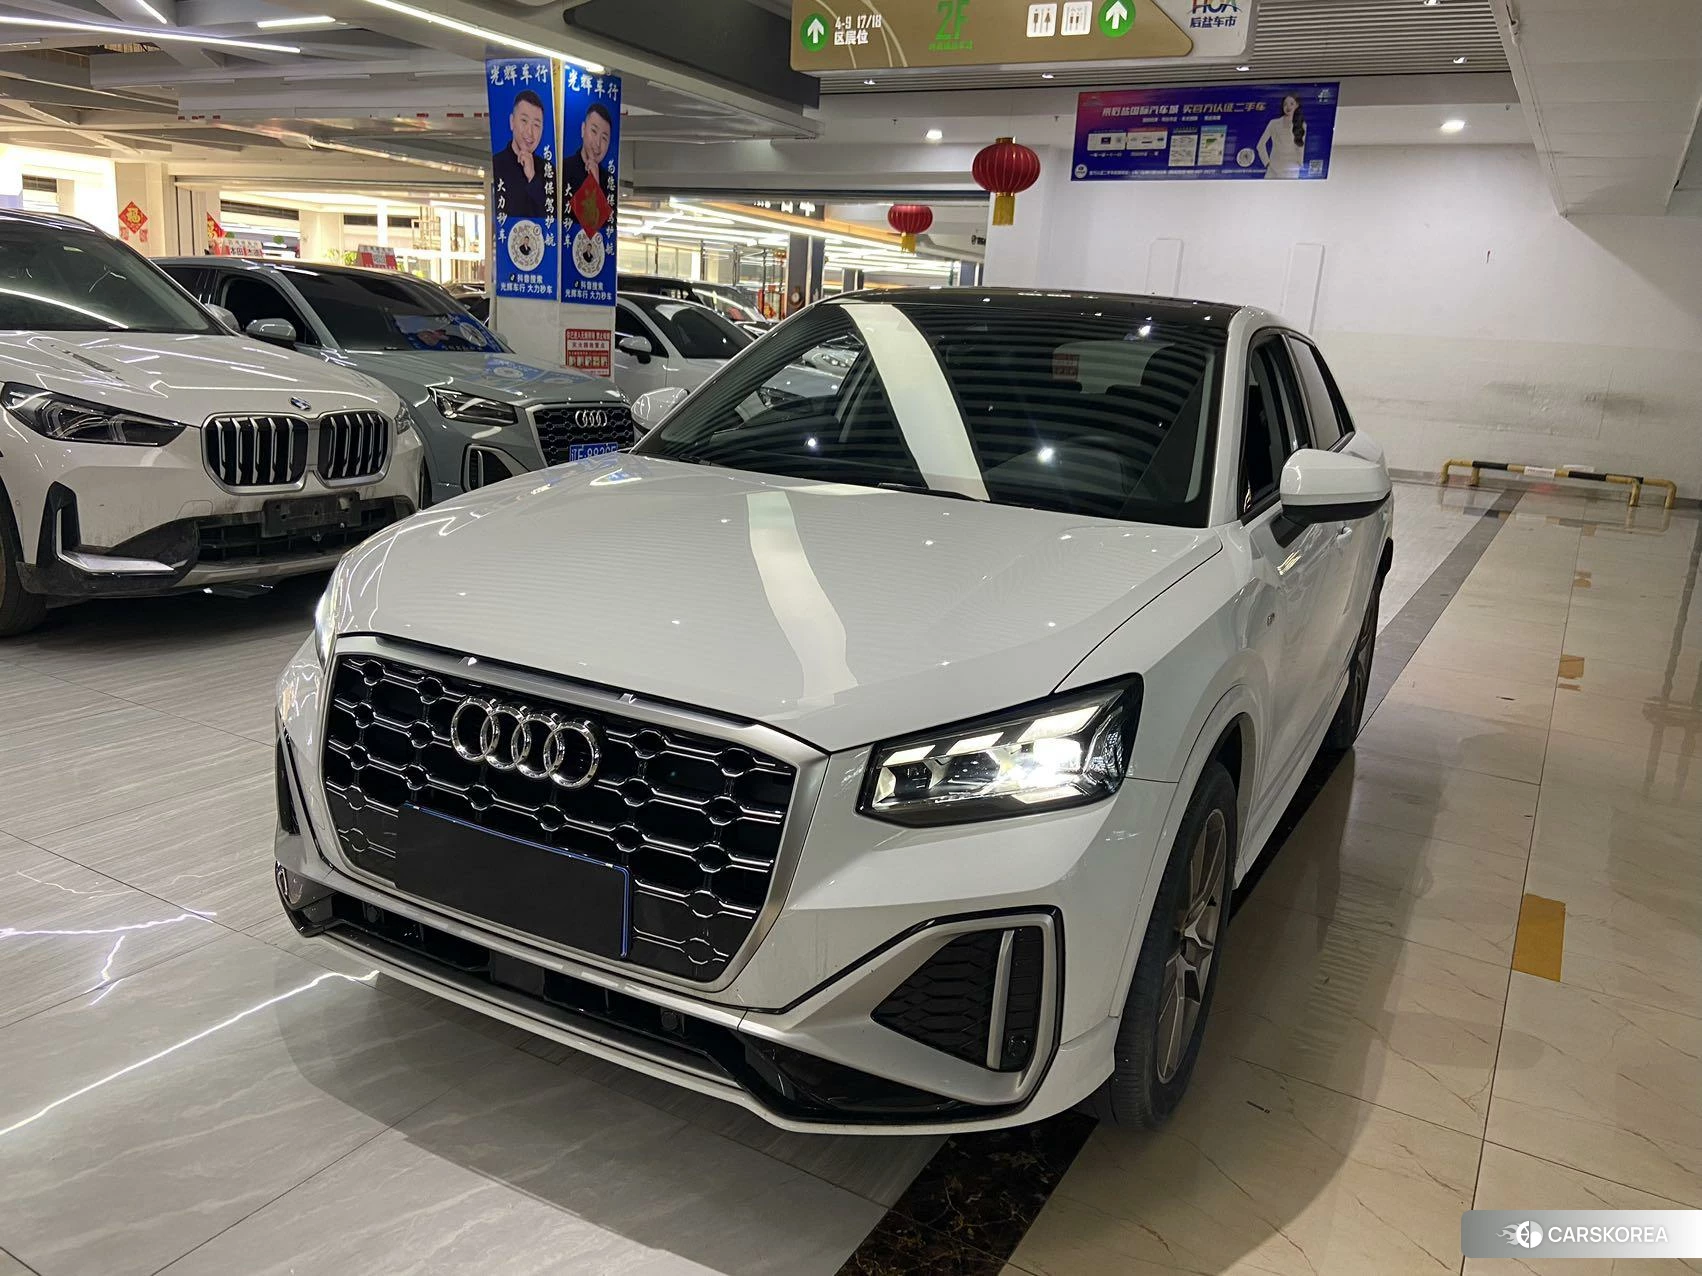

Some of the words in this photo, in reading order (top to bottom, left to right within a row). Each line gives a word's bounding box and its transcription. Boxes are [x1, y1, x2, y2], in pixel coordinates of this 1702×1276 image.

[834, 16, 852, 30] 4-9
[856, 14, 882, 29] 17/18
[936, 0, 970, 40] 2F
[1190, 15, 1237, 29] 后盐车市
[833, 30, 869, 46] 区展位
[490, 63, 548, 86] 光辉车行
[567, 69, 619, 101] 光辉车行
